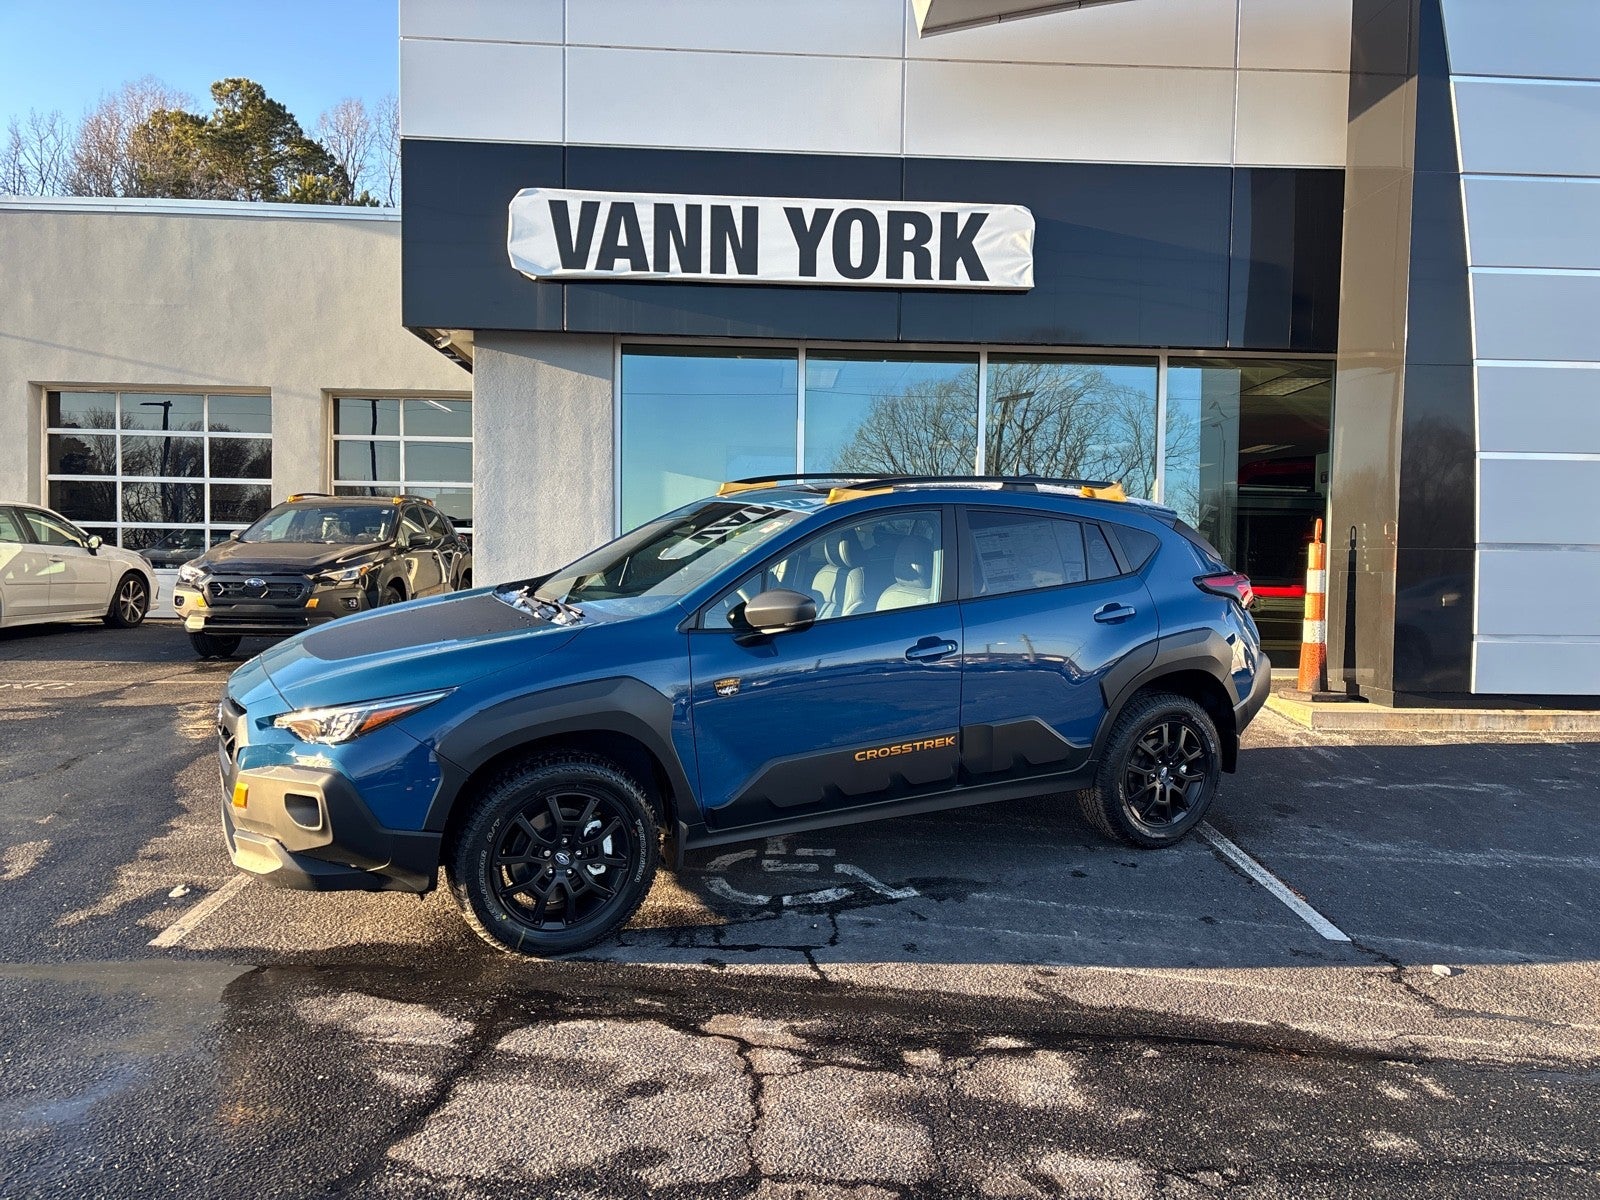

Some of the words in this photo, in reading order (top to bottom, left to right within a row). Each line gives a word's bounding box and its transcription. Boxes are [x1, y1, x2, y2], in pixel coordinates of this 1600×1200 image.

[547, 199, 758, 276] VANN
[783, 206, 990, 282] YORK
[854, 735, 956, 762] CROSSTREK
